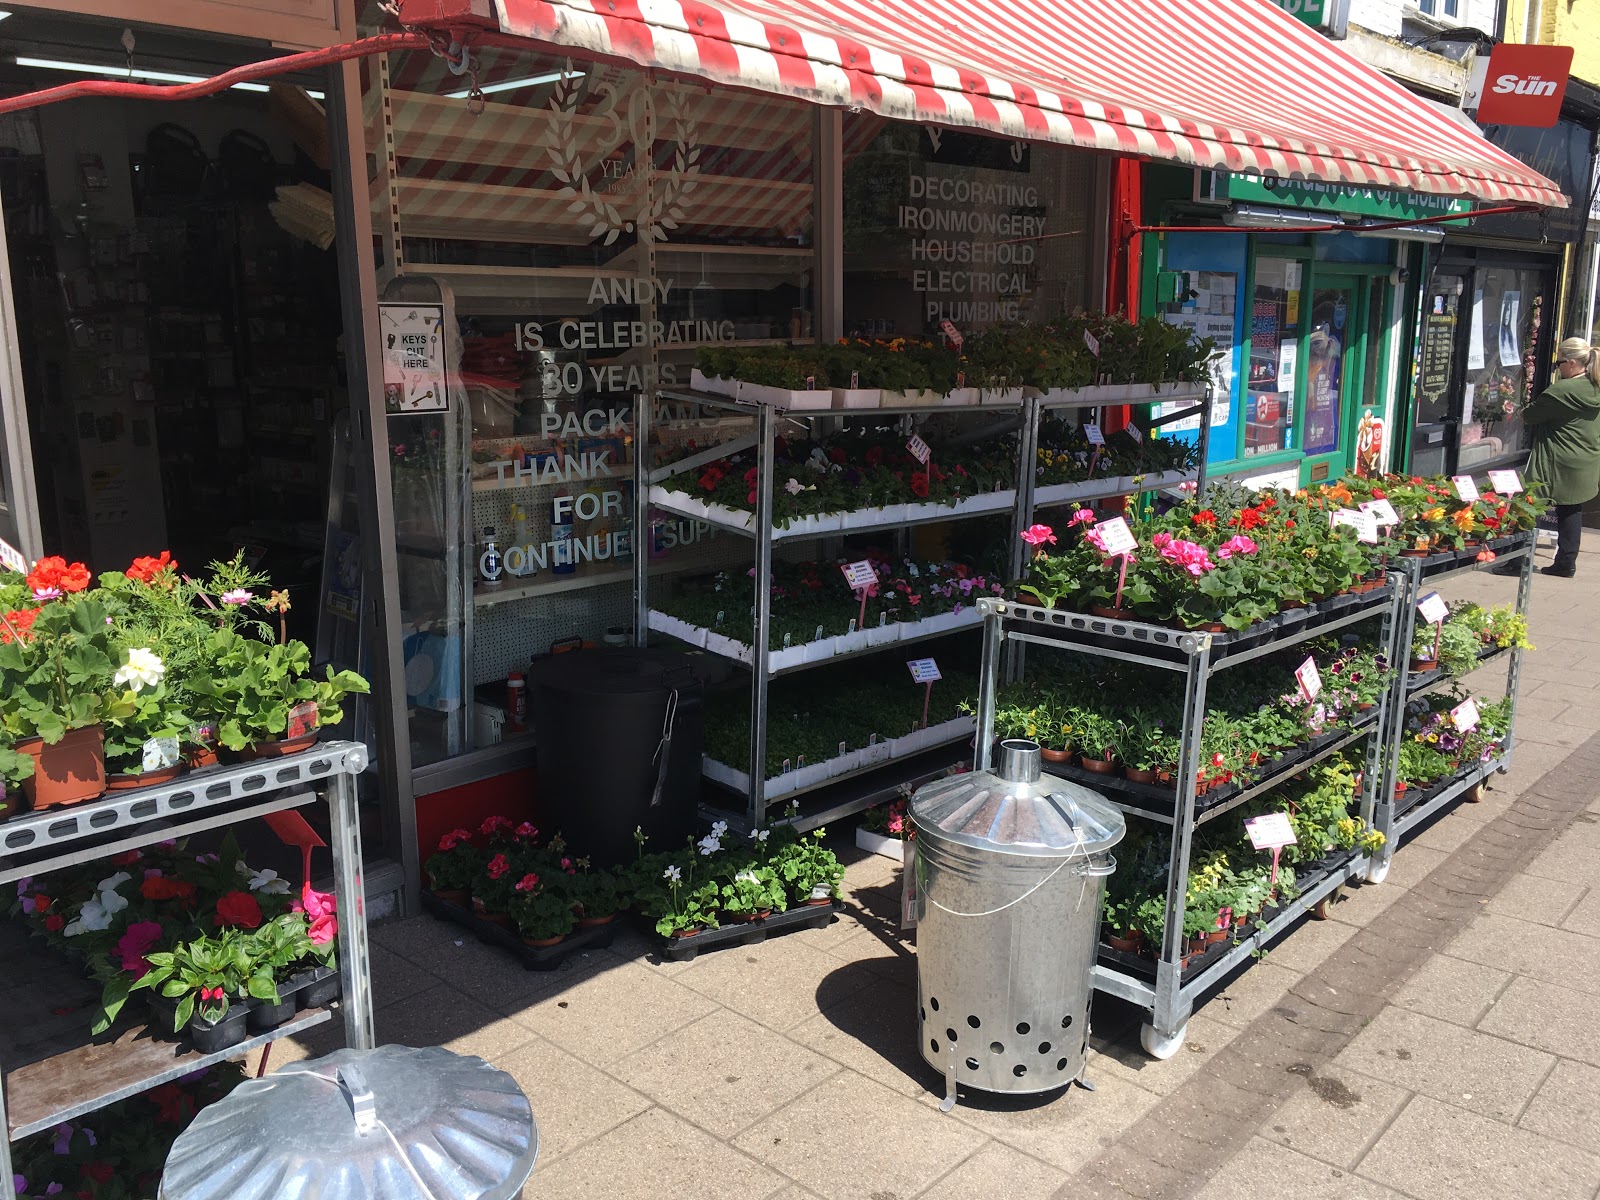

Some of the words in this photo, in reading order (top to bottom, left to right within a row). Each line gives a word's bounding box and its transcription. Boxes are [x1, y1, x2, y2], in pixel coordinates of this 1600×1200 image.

[1492, 74, 1558, 97] Sun
[595, 82, 657, 150] 30
[909, 175, 1038, 208] DECORATING
[898, 205, 1047, 237] IRONMONGERY
[911, 238, 1035, 265] HOUSEHOLD
[586, 278, 674, 305] ANDY
[913, 269, 1032, 294] ELECTRICAL
[926, 301, 1019, 323] PLUMBING
[1253, 302, 1277, 316] IGGER
[514, 322, 545, 351] IS
[559, 320, 736, 349] CELEBRATING
[1251, 316, 1276, 334] CASH
[402, 335, 427, 344] KEYS
[406, 347, 425, 356] CUT
[403, 359, 429, 368] HERE
[542, 362, 584, 396] 30
[1257, 443, 1278, 454] MILLION
[487, 450, 613, 488] THANK
[553, 490, 624, 524] FOR
[479, 529, 634, 579] CONTINUE
